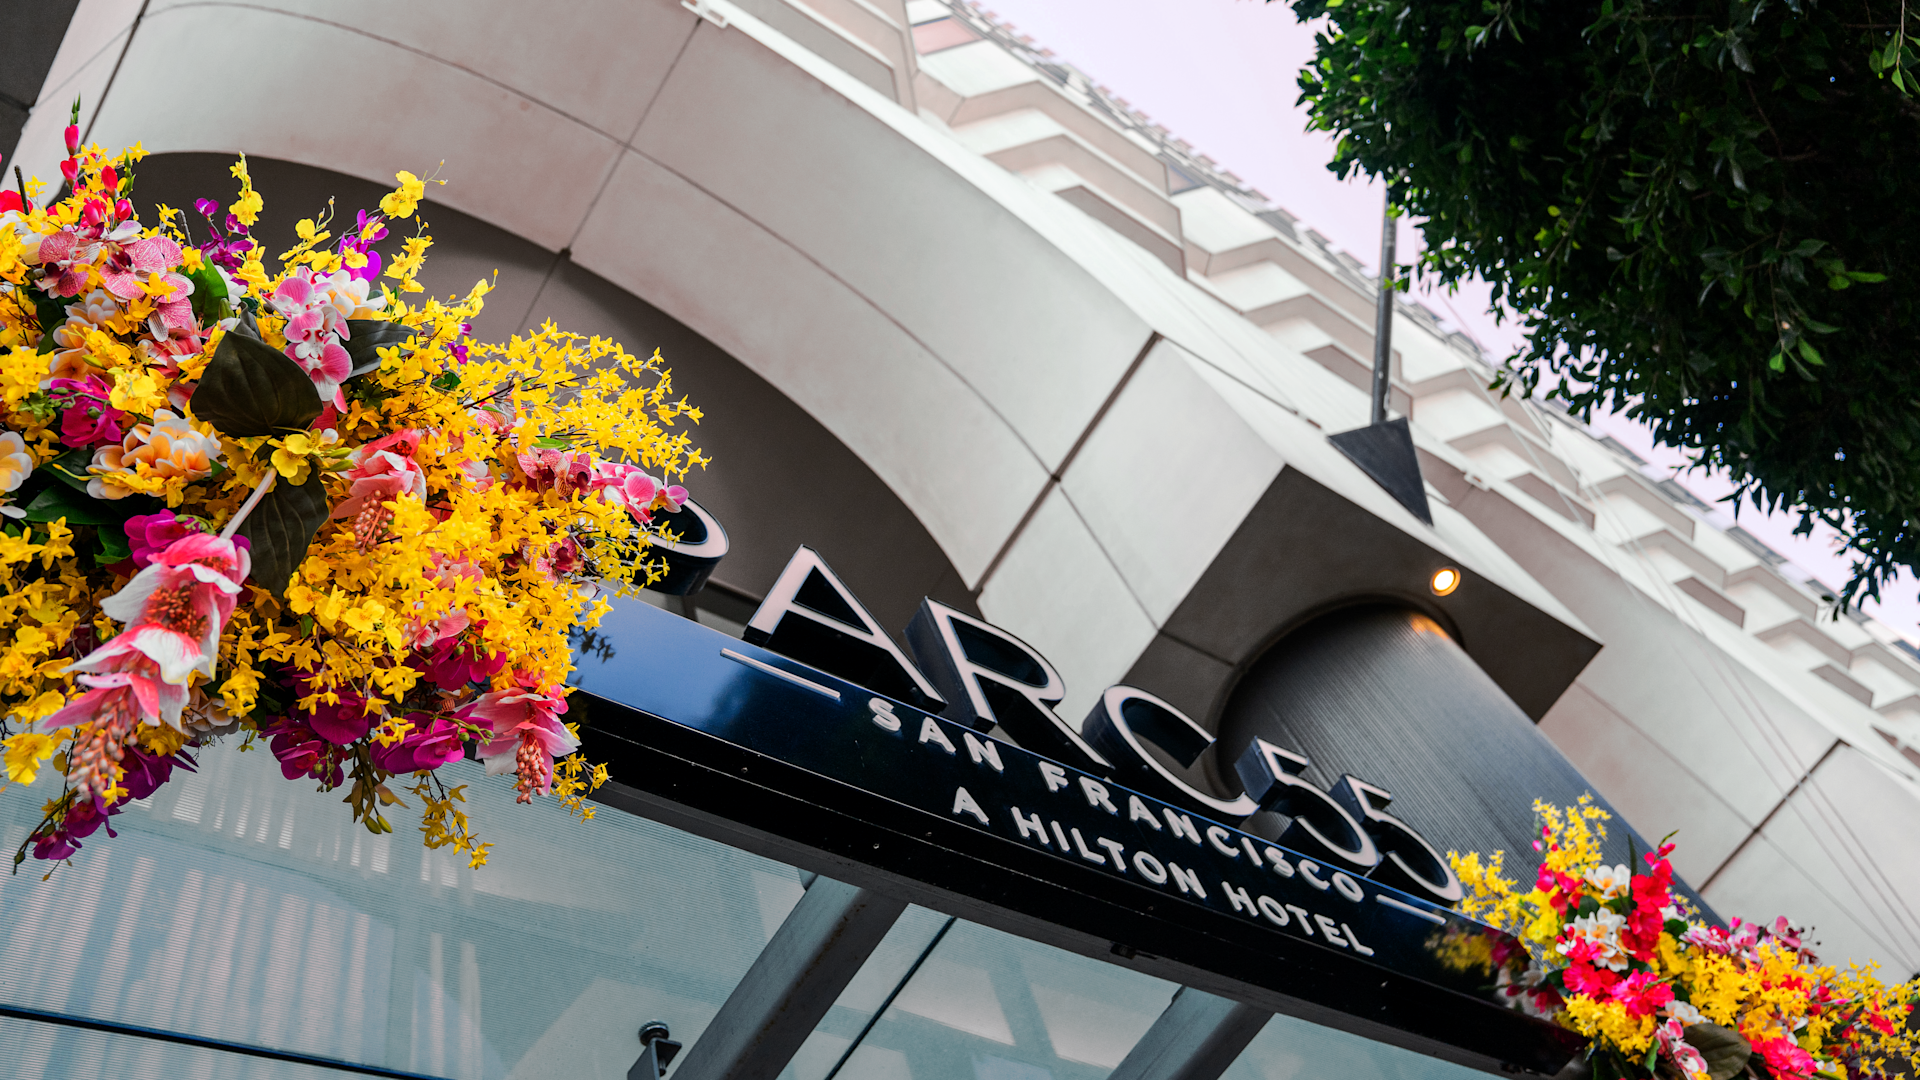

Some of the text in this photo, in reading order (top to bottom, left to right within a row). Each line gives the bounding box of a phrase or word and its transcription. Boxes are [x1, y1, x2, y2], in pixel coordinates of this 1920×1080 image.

[868, 697, 1364, 902] SAN FRANCISCO
[953, 786, 1375, 957] A HILTON HOTEL
